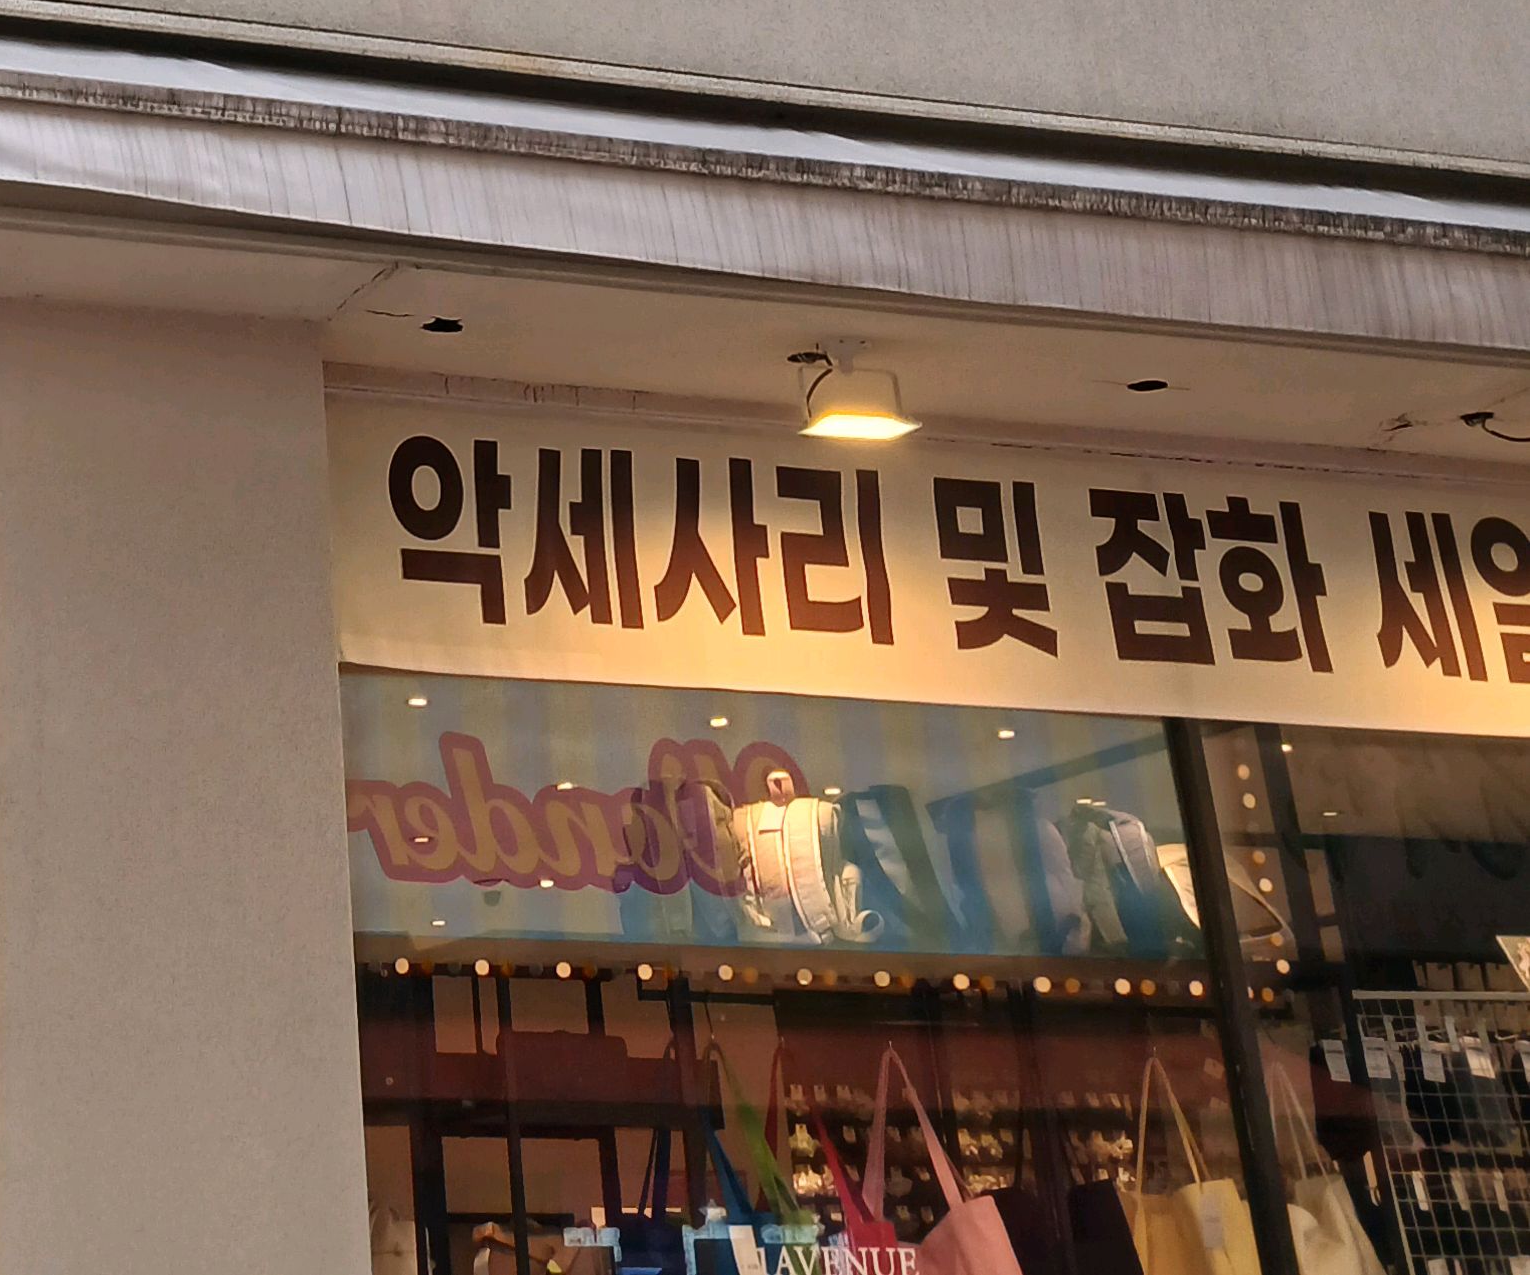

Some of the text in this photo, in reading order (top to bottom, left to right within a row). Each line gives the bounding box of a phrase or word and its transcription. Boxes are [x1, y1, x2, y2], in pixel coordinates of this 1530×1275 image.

[387, 434, 895, 646] 악세사리
[933, 476, 1059, 659] 및
[1088, 487, 1335, 674] 잡화
